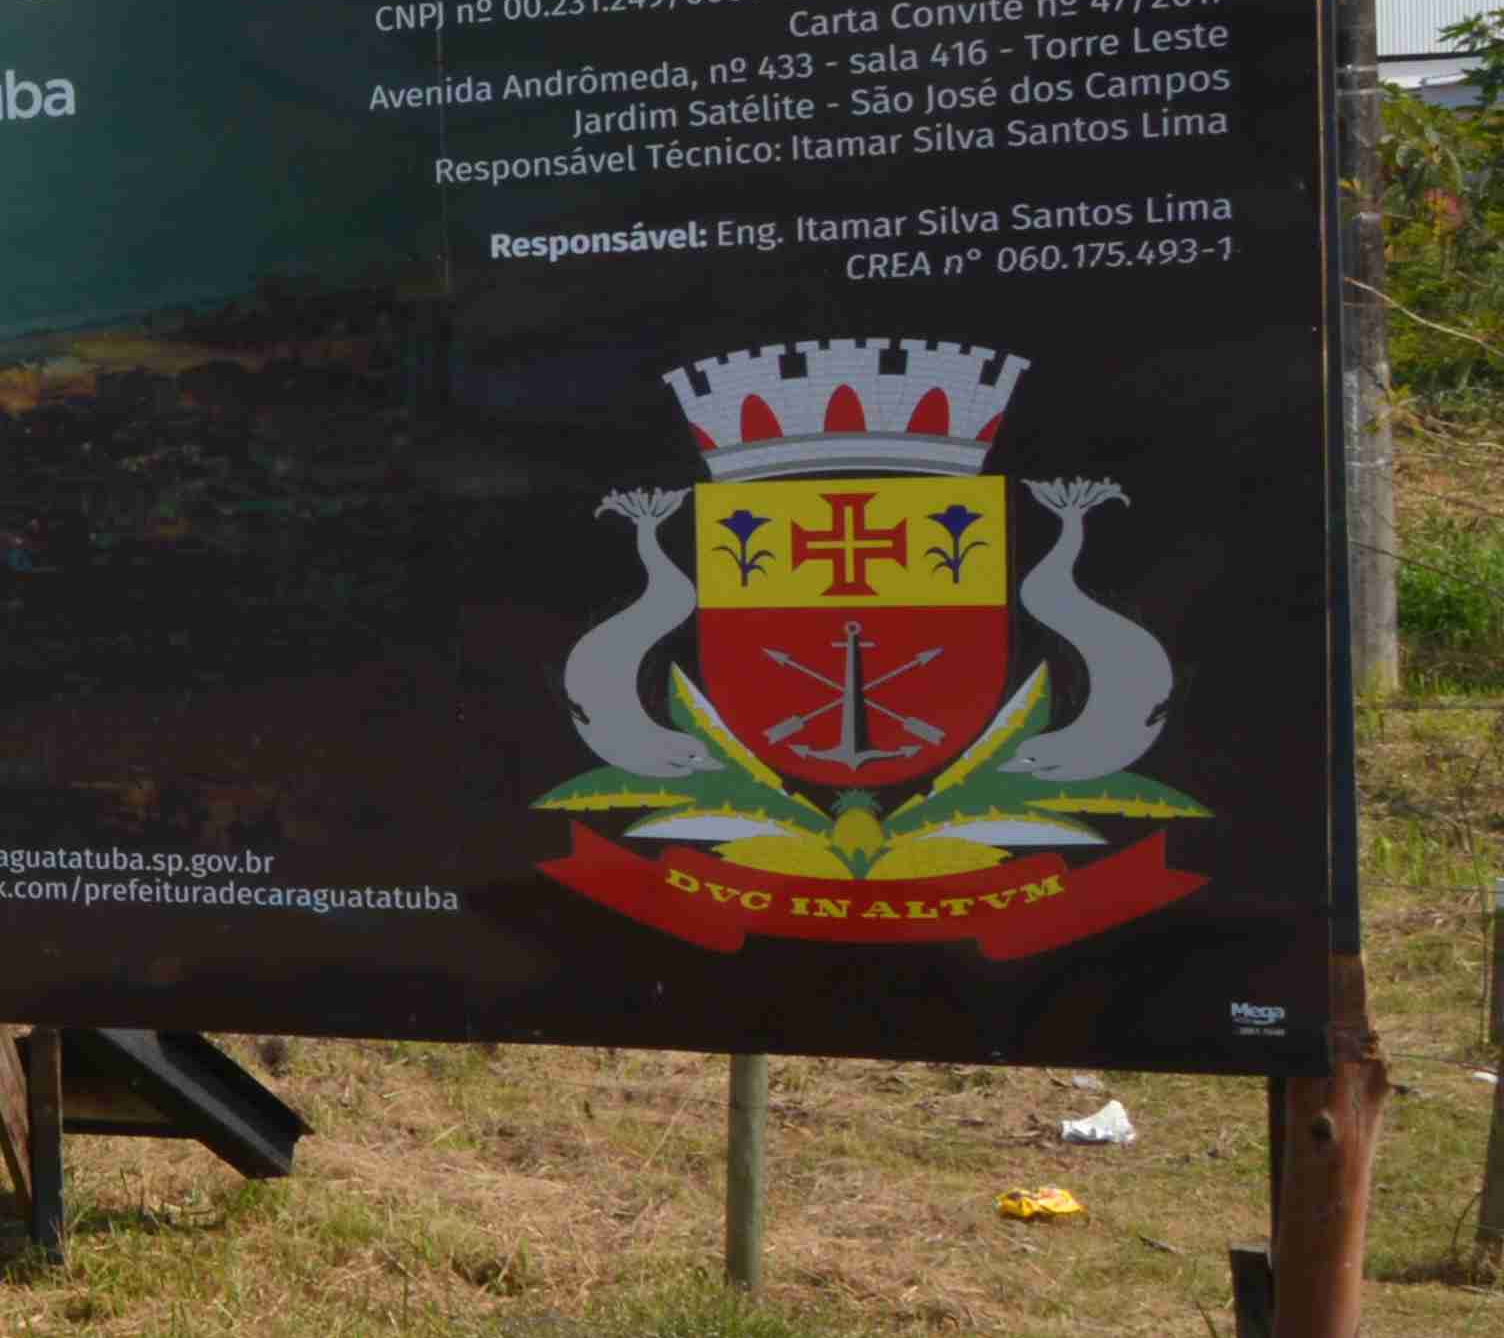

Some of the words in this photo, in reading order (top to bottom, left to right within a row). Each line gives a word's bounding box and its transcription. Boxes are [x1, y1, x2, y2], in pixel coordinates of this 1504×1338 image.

[374, 0, 445, 32] CNPJ
[788, 8, 879, 39] Carta
[368, 75, 493, 111] Avenida
[502, 60, 699, 101] Andrômeda,
[757, 51, 814, 81] 433
[849, 43, 919, 75] sala
[929, 38, 988, 68] 416
[1022, 33, 1120, 61] Torre
[1133, 23, 1229, 54] Leste
[572, 101, 678, 140] Jardim
[688, 91, 815, 128] Satélite
[850, 84, 914, 116] São
[924, 76, 998, 115] José
[1009, 75, 1074, 105] dos
[1084, 68, 1231, 102] Campos
[434, 143, 636, 187] Responsável
[645, 135, 782, 170] Técnico:
[791, 133, 903, 161] Itamar
[912, 122, 995, 154] Silva
[1006, 117, 1130, 148] Santos
[1141, 107, 1228, 139] Lima
[490, 219, 709, 264] Responsável:
[716, 219, 784, 252] Eng.
[796, 215, 908, 243] Itamar
[917, 205, 999, 237] Silva
[1011, 201, 1134, 231] Santos
[1146, 192, 1233, 224] Lima
[845, 250, 932, 281] CREA
[996, 235, 1232, 273] 060.175.493-1
[665, 868, 772, 911] DVC
[790, 896, 852, 919] IN
[860, 873, 1066, 919] ALTVM
